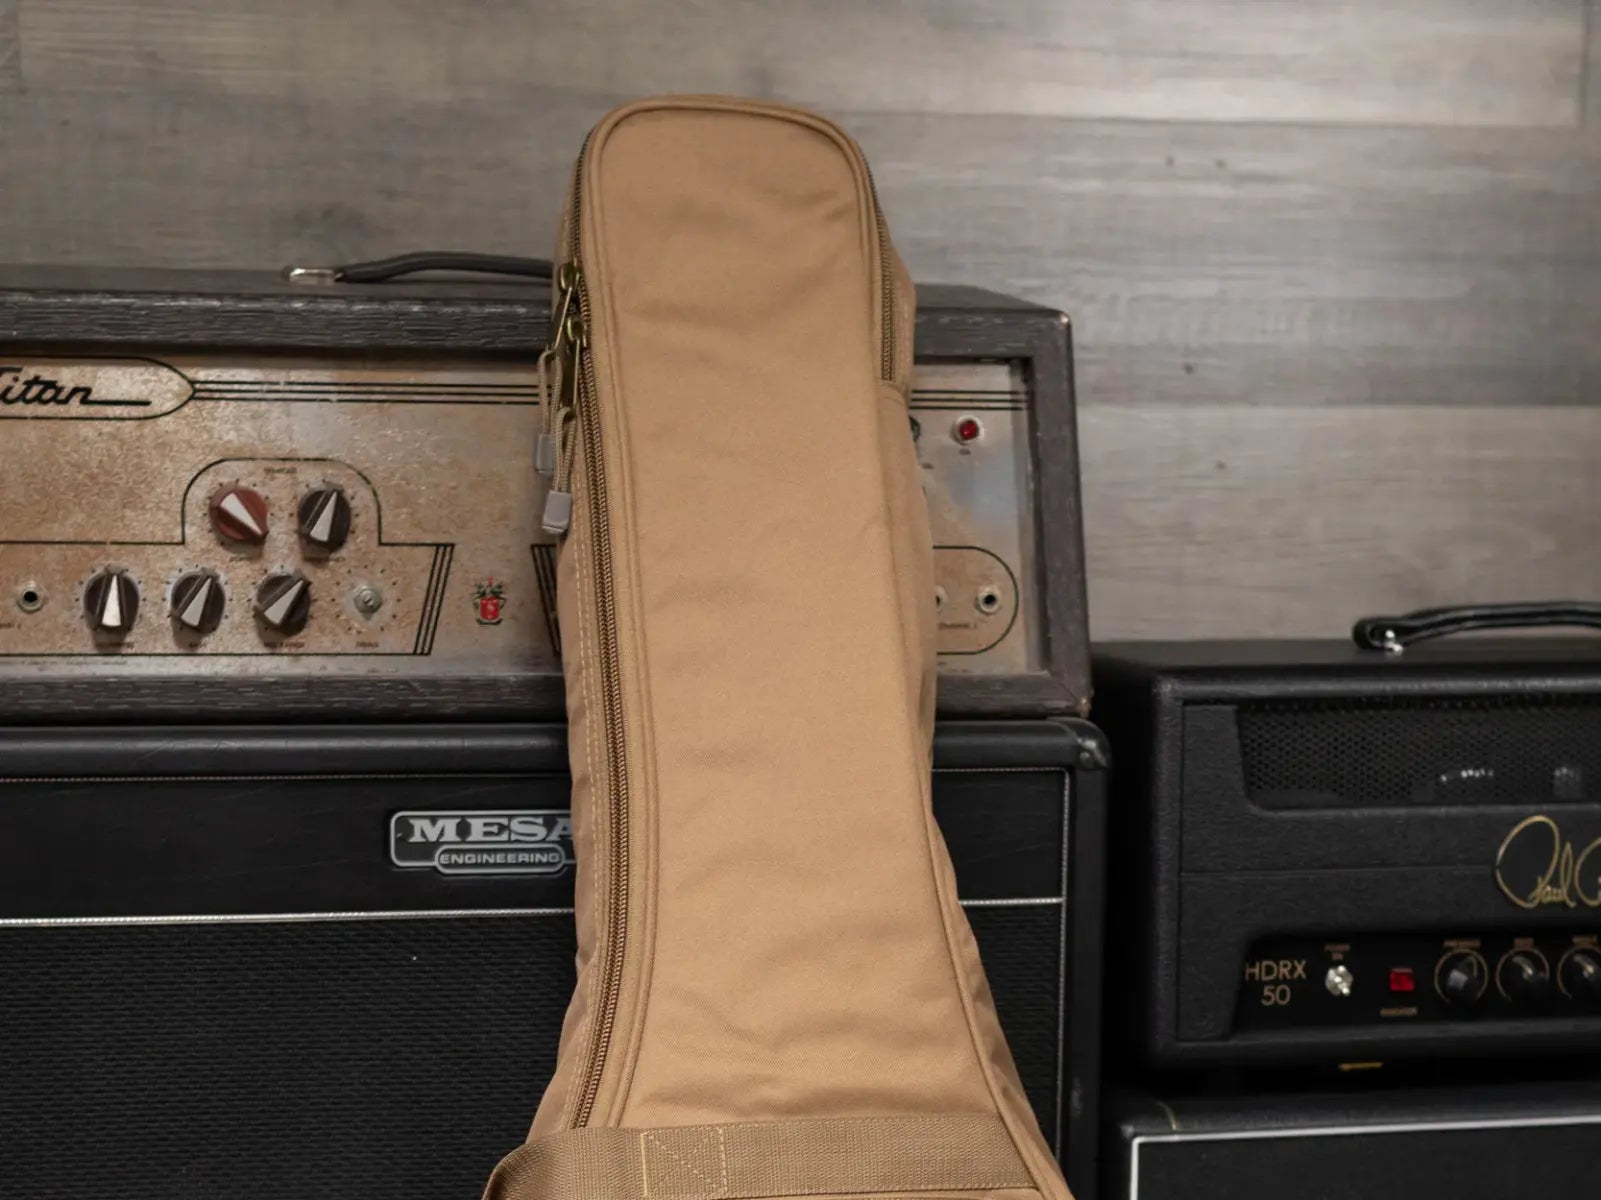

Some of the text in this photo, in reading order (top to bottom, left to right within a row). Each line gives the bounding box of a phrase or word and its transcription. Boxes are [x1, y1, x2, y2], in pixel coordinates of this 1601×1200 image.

[439, 852, 561, 864] ENGINEERING
[1244, 959, 1307, 981] HDRX
[1261, 984, 1292, 1006] 50
